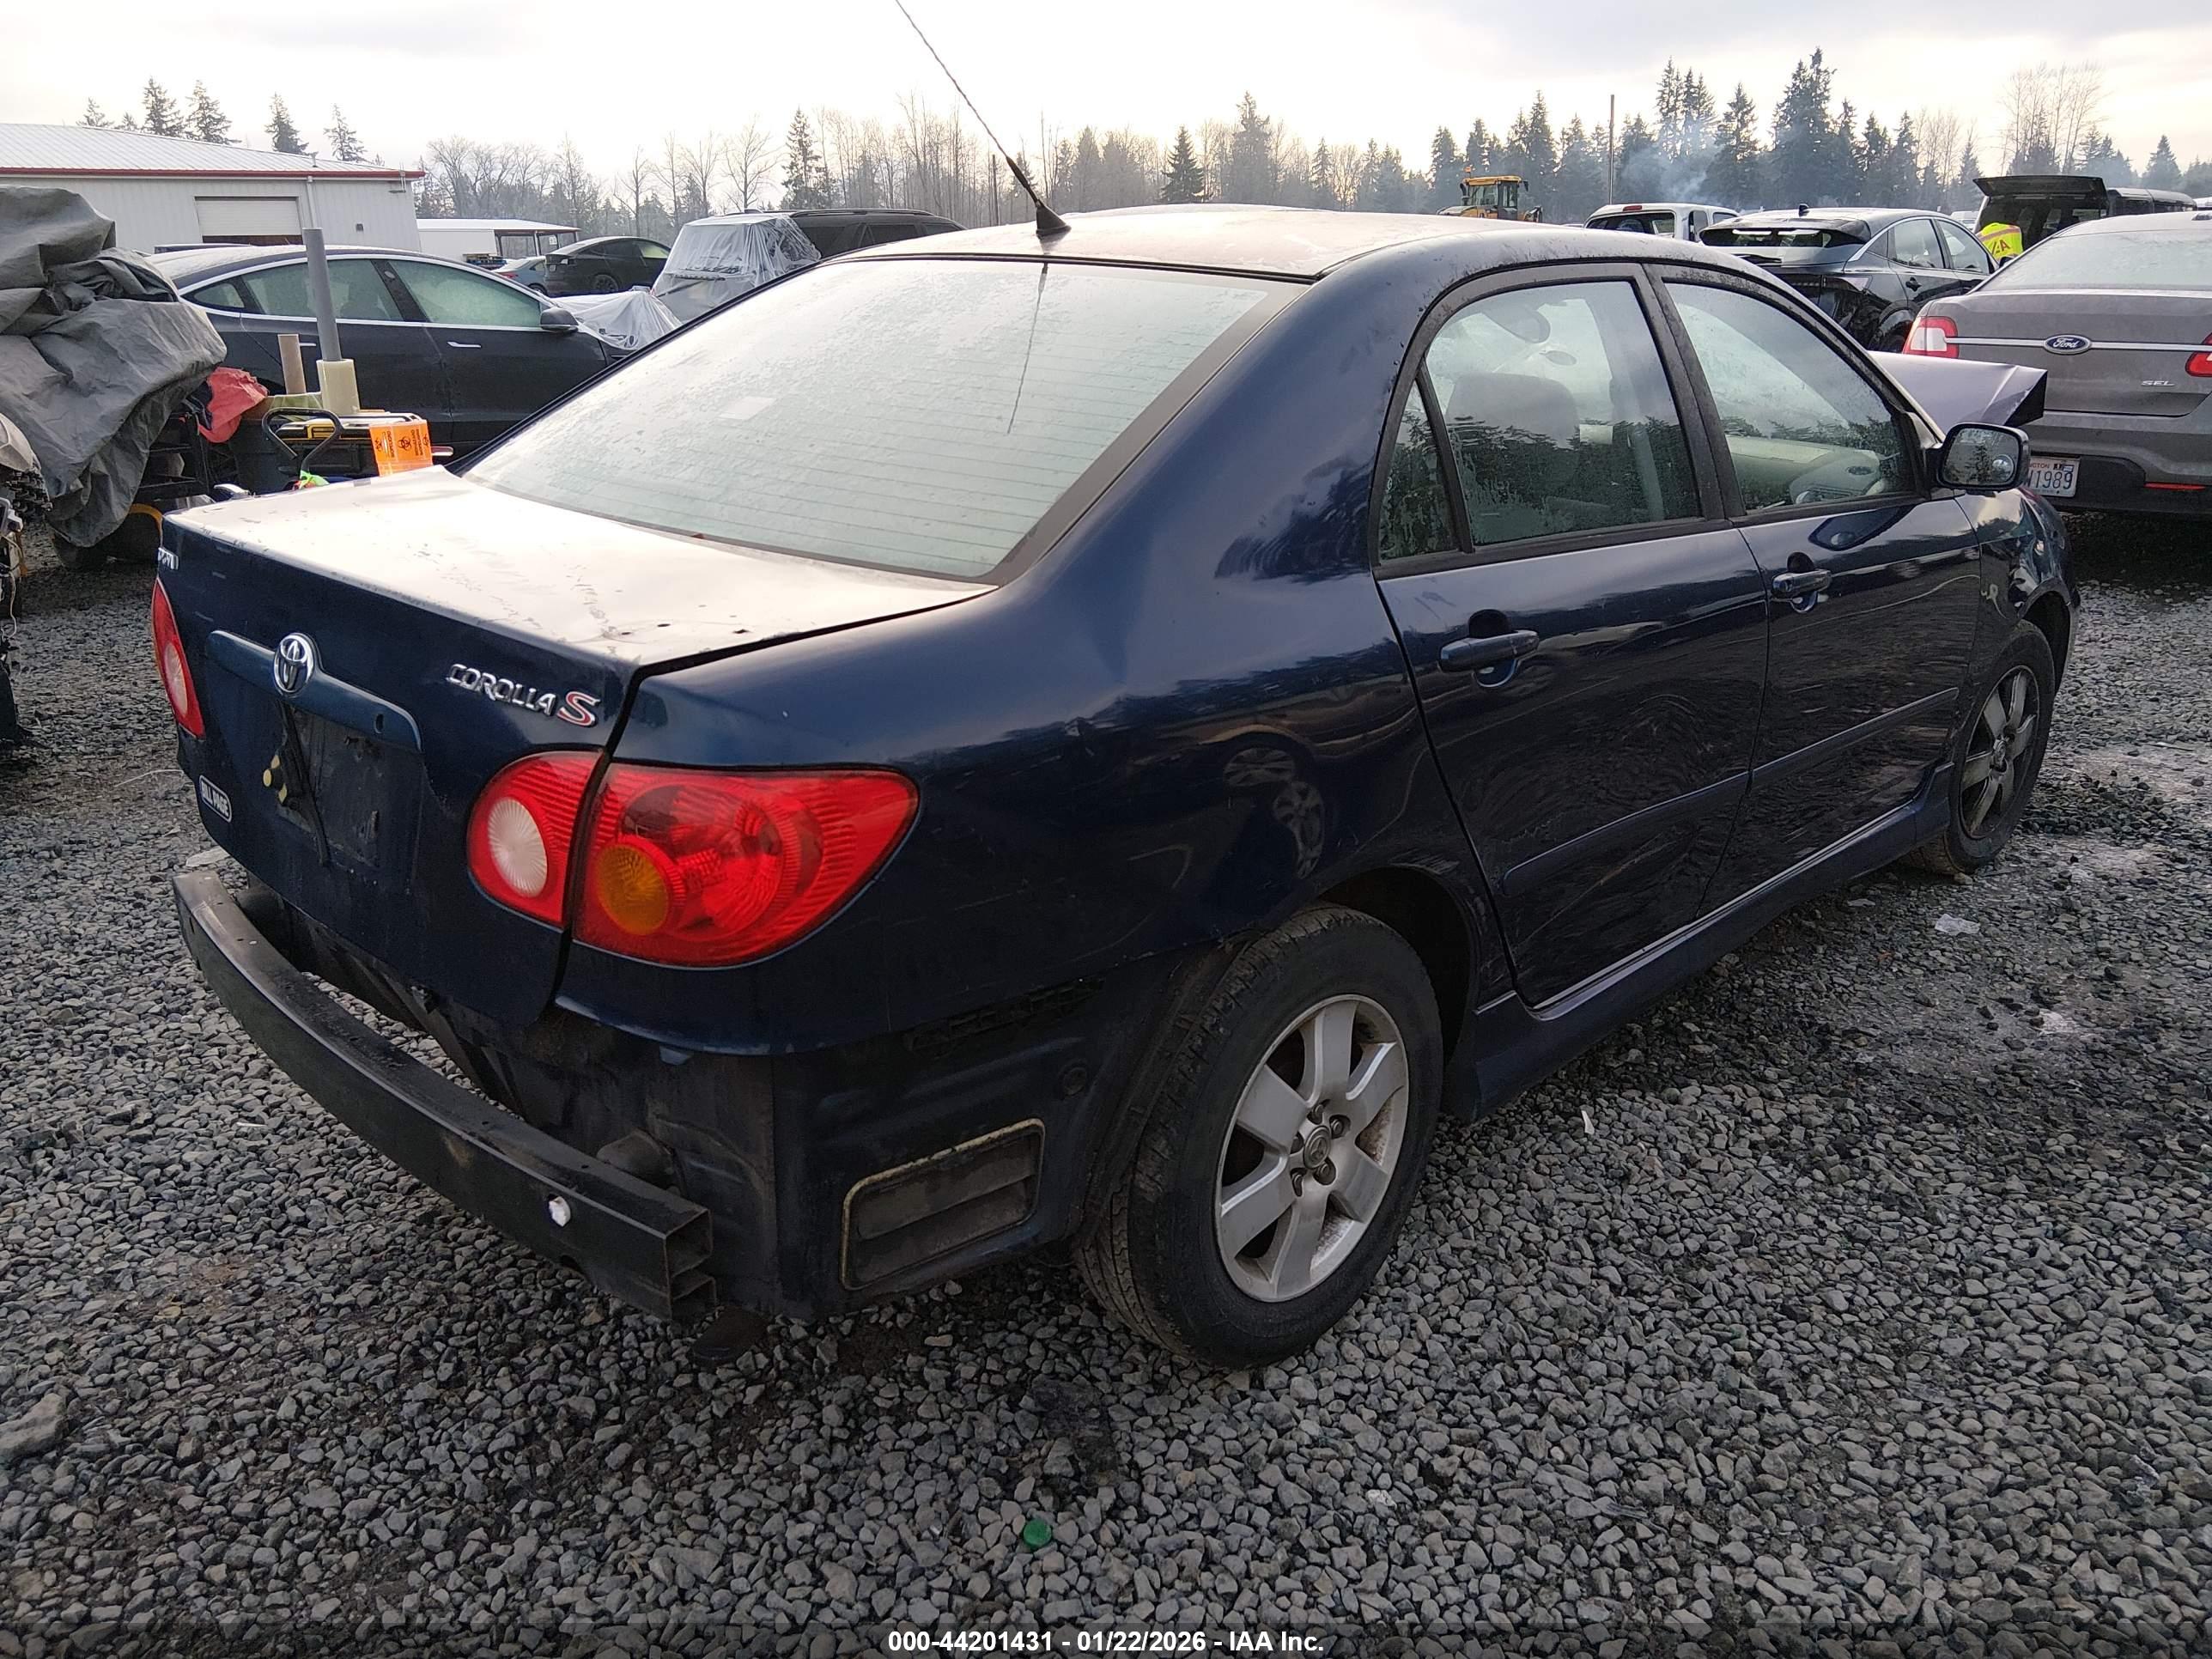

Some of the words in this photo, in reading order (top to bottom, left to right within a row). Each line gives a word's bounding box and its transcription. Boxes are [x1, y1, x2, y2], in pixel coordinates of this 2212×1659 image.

[2052, 337, 2080, 349] Ford
[445, 663, 556, 717] COROLLA
[556, 690, 601, 726] S
